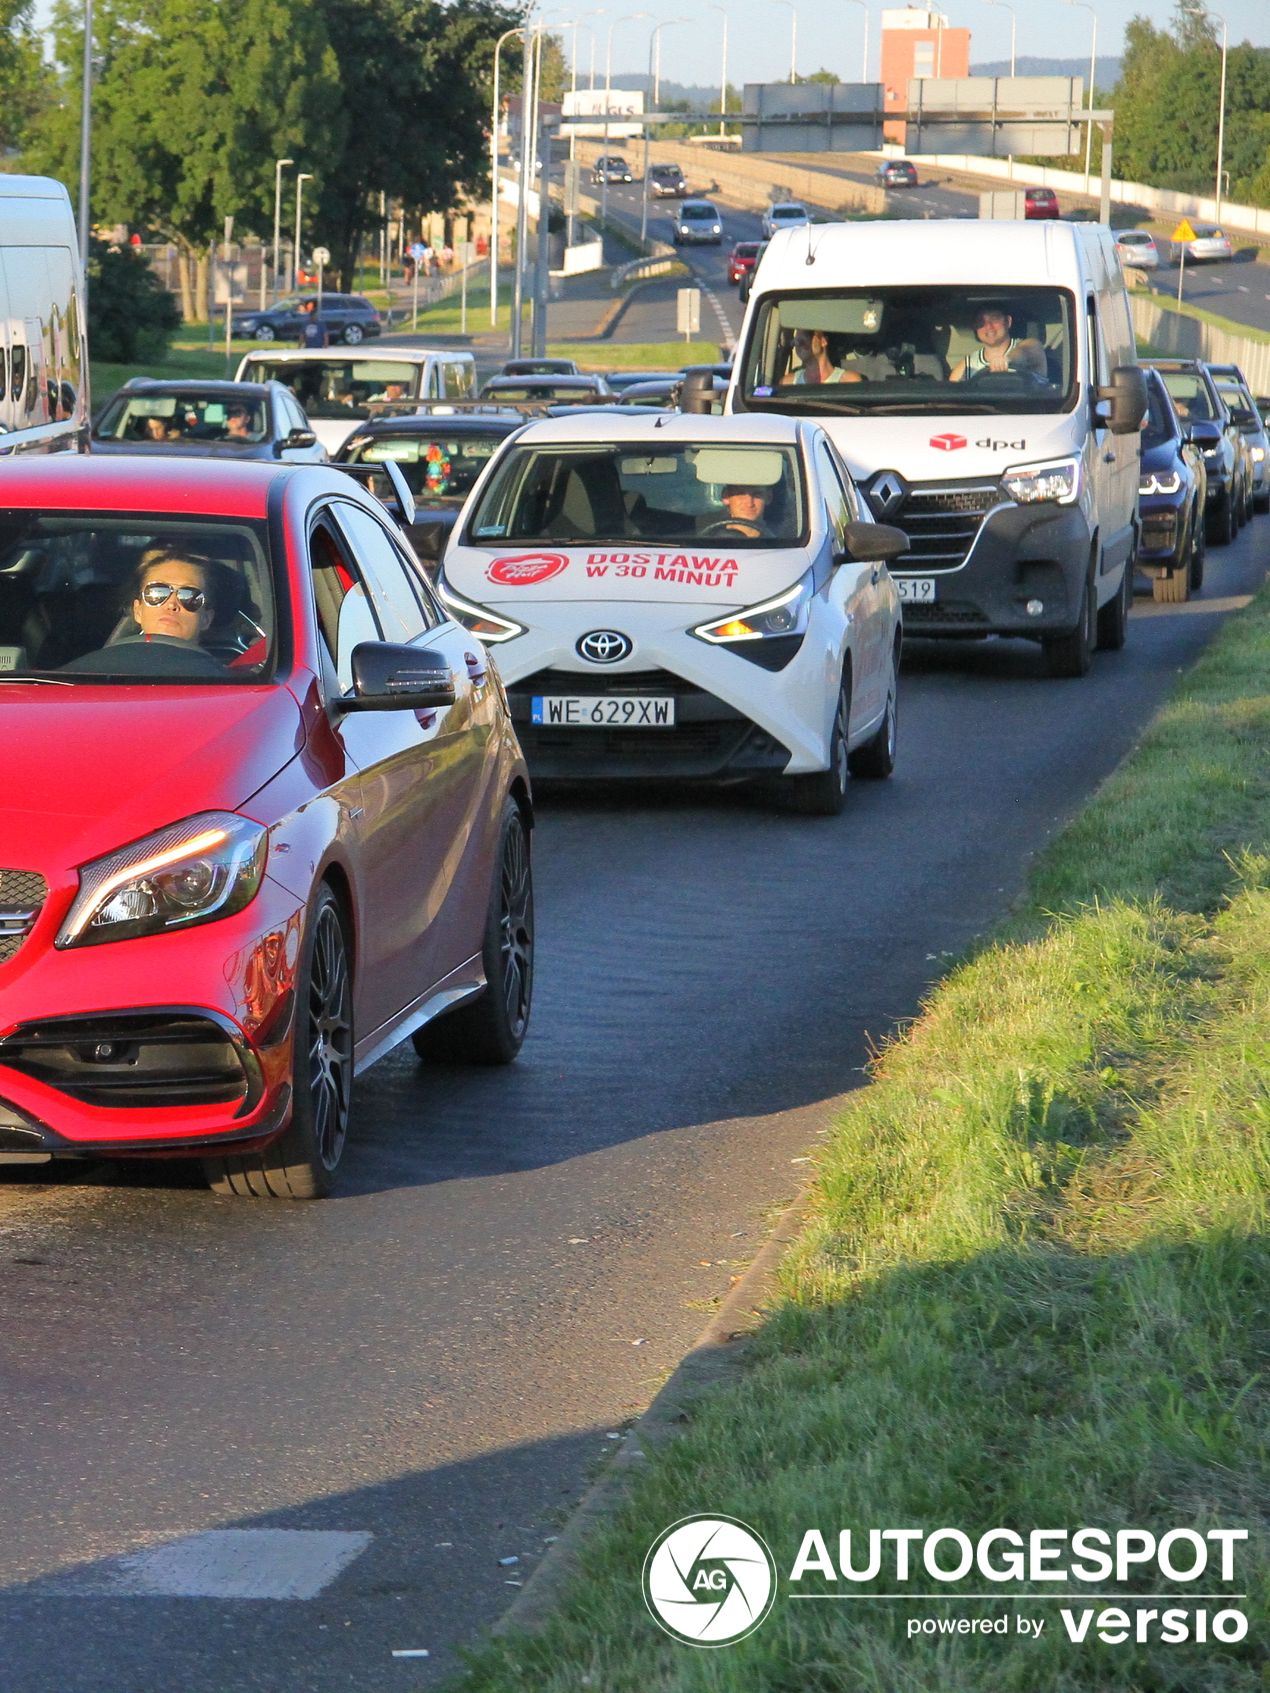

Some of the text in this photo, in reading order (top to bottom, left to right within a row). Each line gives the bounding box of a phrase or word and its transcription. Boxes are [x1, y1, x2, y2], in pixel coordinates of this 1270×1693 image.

[975, 437, 1026, 451] dpd
[586, 552, 739, 572] DOSTAWA
[585, 566, 739, 588] W 30 MINUT
[898, 581, 931, 598] 519
[548, 700, 669, 723] WE 629XW
